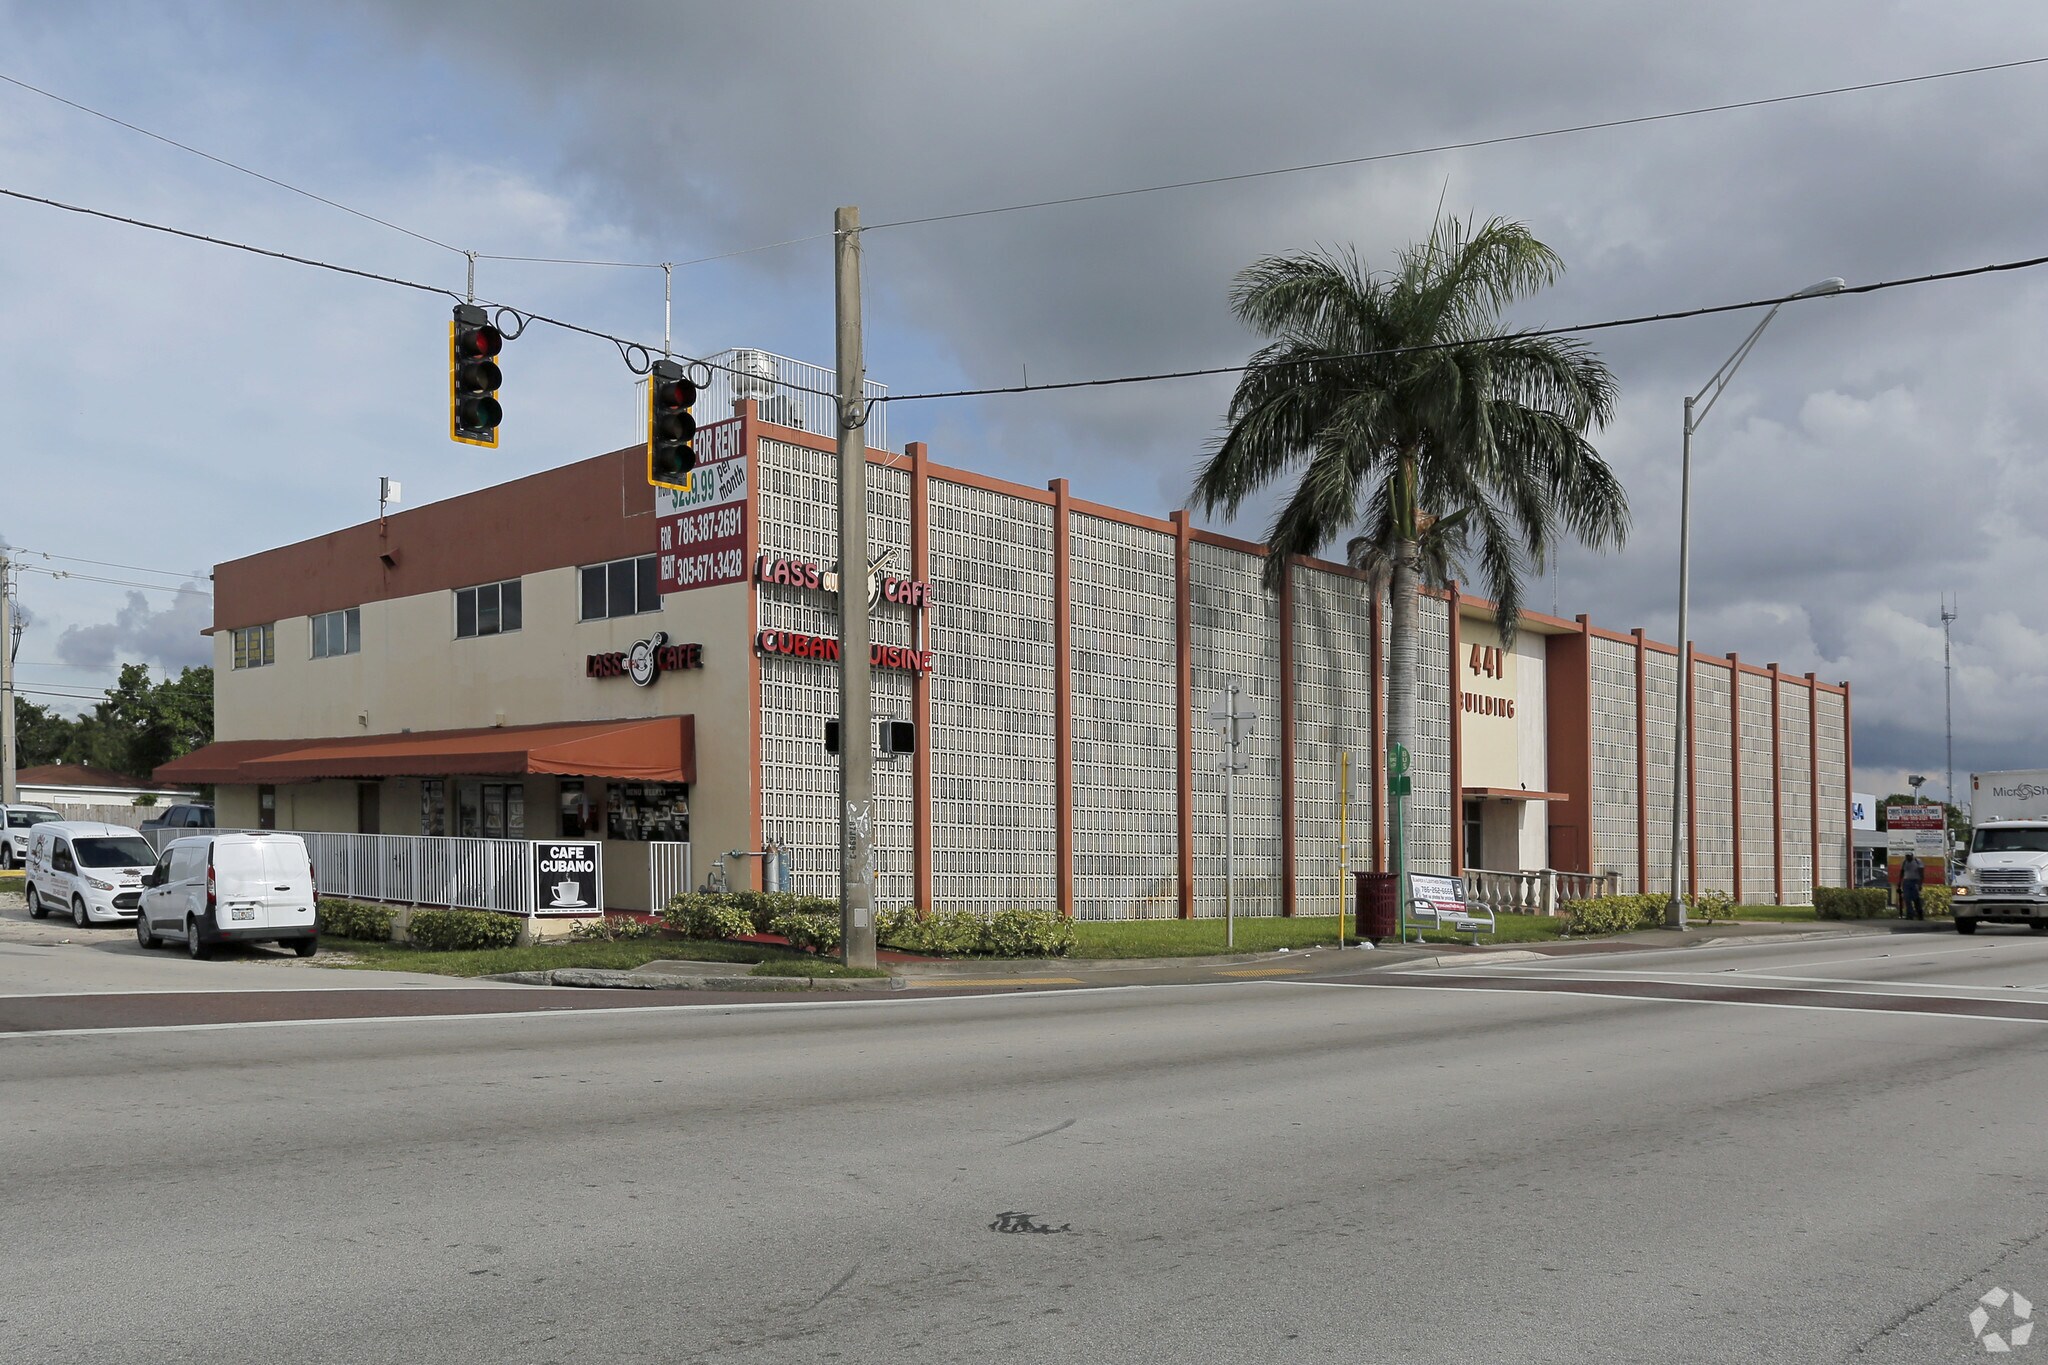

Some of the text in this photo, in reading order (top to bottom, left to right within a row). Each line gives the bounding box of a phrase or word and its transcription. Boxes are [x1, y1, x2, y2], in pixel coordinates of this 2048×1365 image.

[694, 421, 742, 464] FOR RENT
[717, 460, 731, 483] per
[719, 464, 746, 502] month
[661, 526, 672, 551] FOR
[677, 506, 742, 546] 786-387-2691
[661, 554, 675, 580] RENT
[677, 548, 742, 586] 305-671-3428
[759, 555, 819, 590] LASS
[883, 577, 933, 609] CAFE
[587, 652, 624, 678] LASS
[657, 644, 696, 671] CAFE
[760, 629, 933, 671] CUBAN UISINE
[1469, 643, 1503, 680] 441
[540, 860, 594, 873] CUBANO
[550, 846, 585, 859] CAFE
